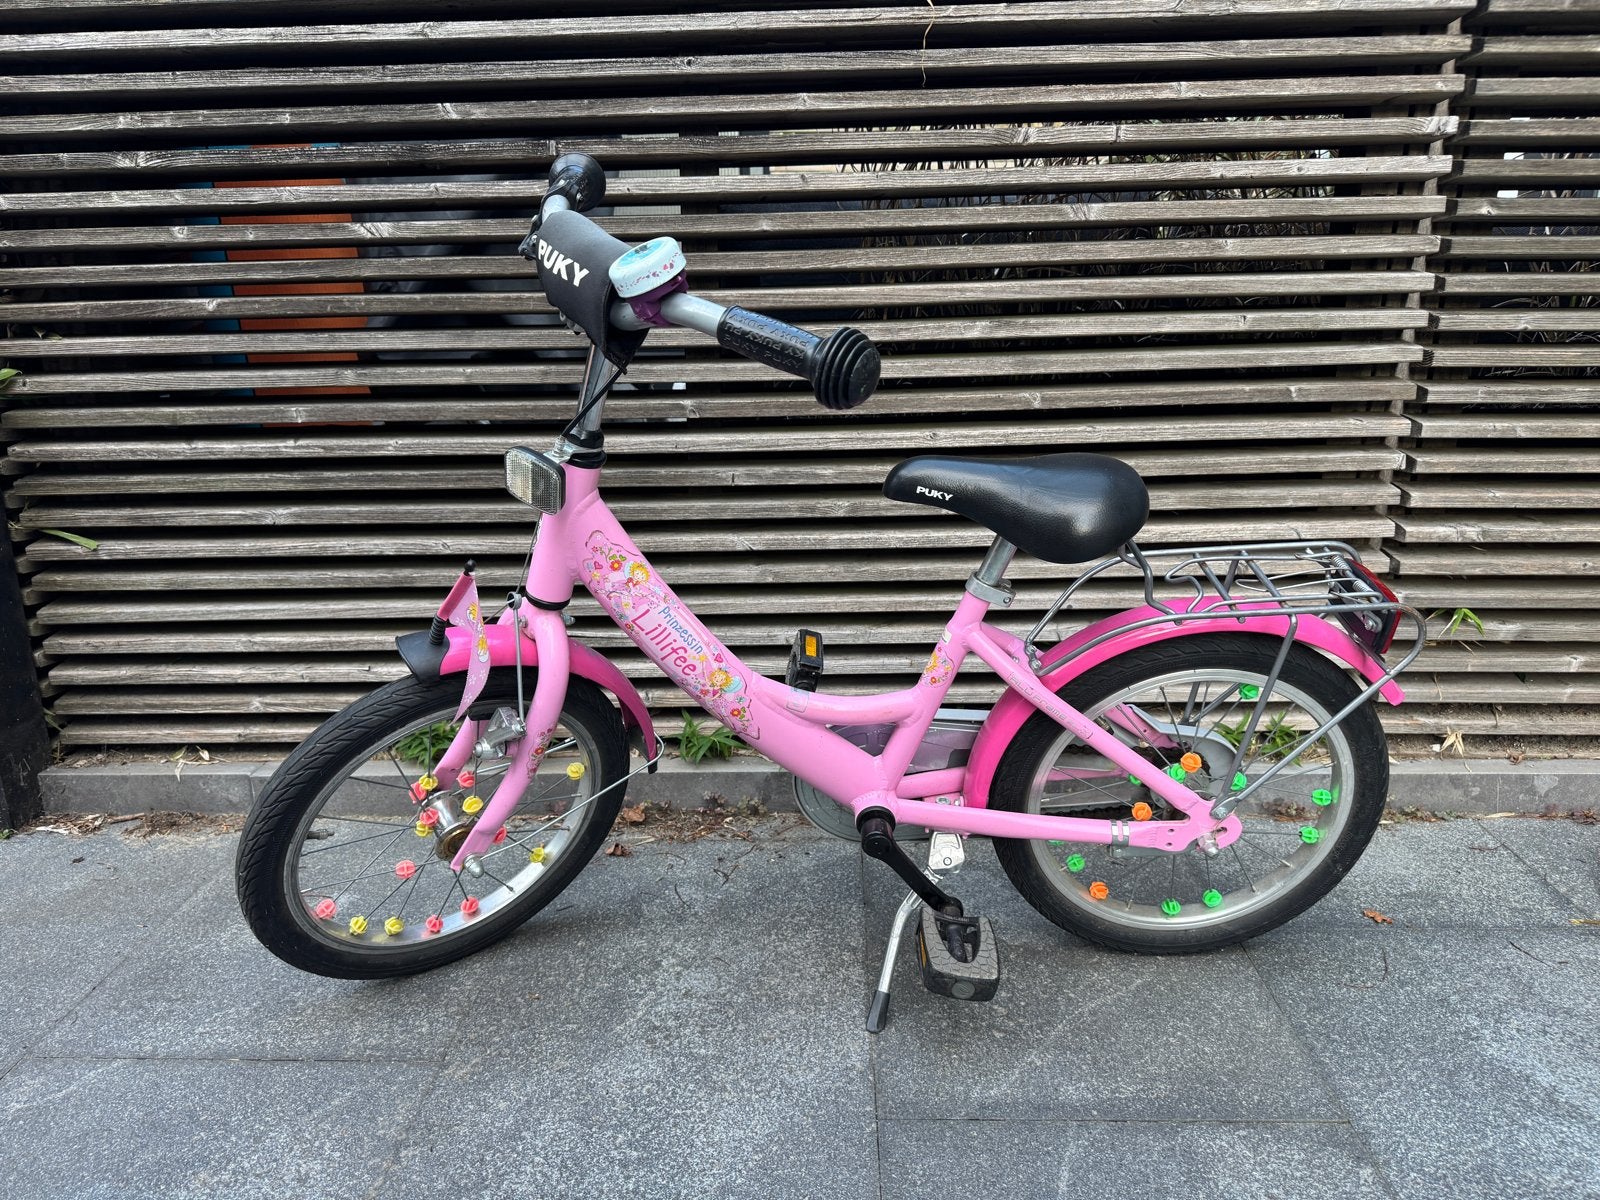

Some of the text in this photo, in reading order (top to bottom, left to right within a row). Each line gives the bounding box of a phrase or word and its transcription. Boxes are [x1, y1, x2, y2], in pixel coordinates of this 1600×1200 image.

[538, 239, 590, 287] PUKY
[744, 329, 782, 350] PUKY
[916, 485, 954, 501] PUKY
[631, 609, 696, 676] Lillifee
[658, 606, 703, 654] Prinzessin
